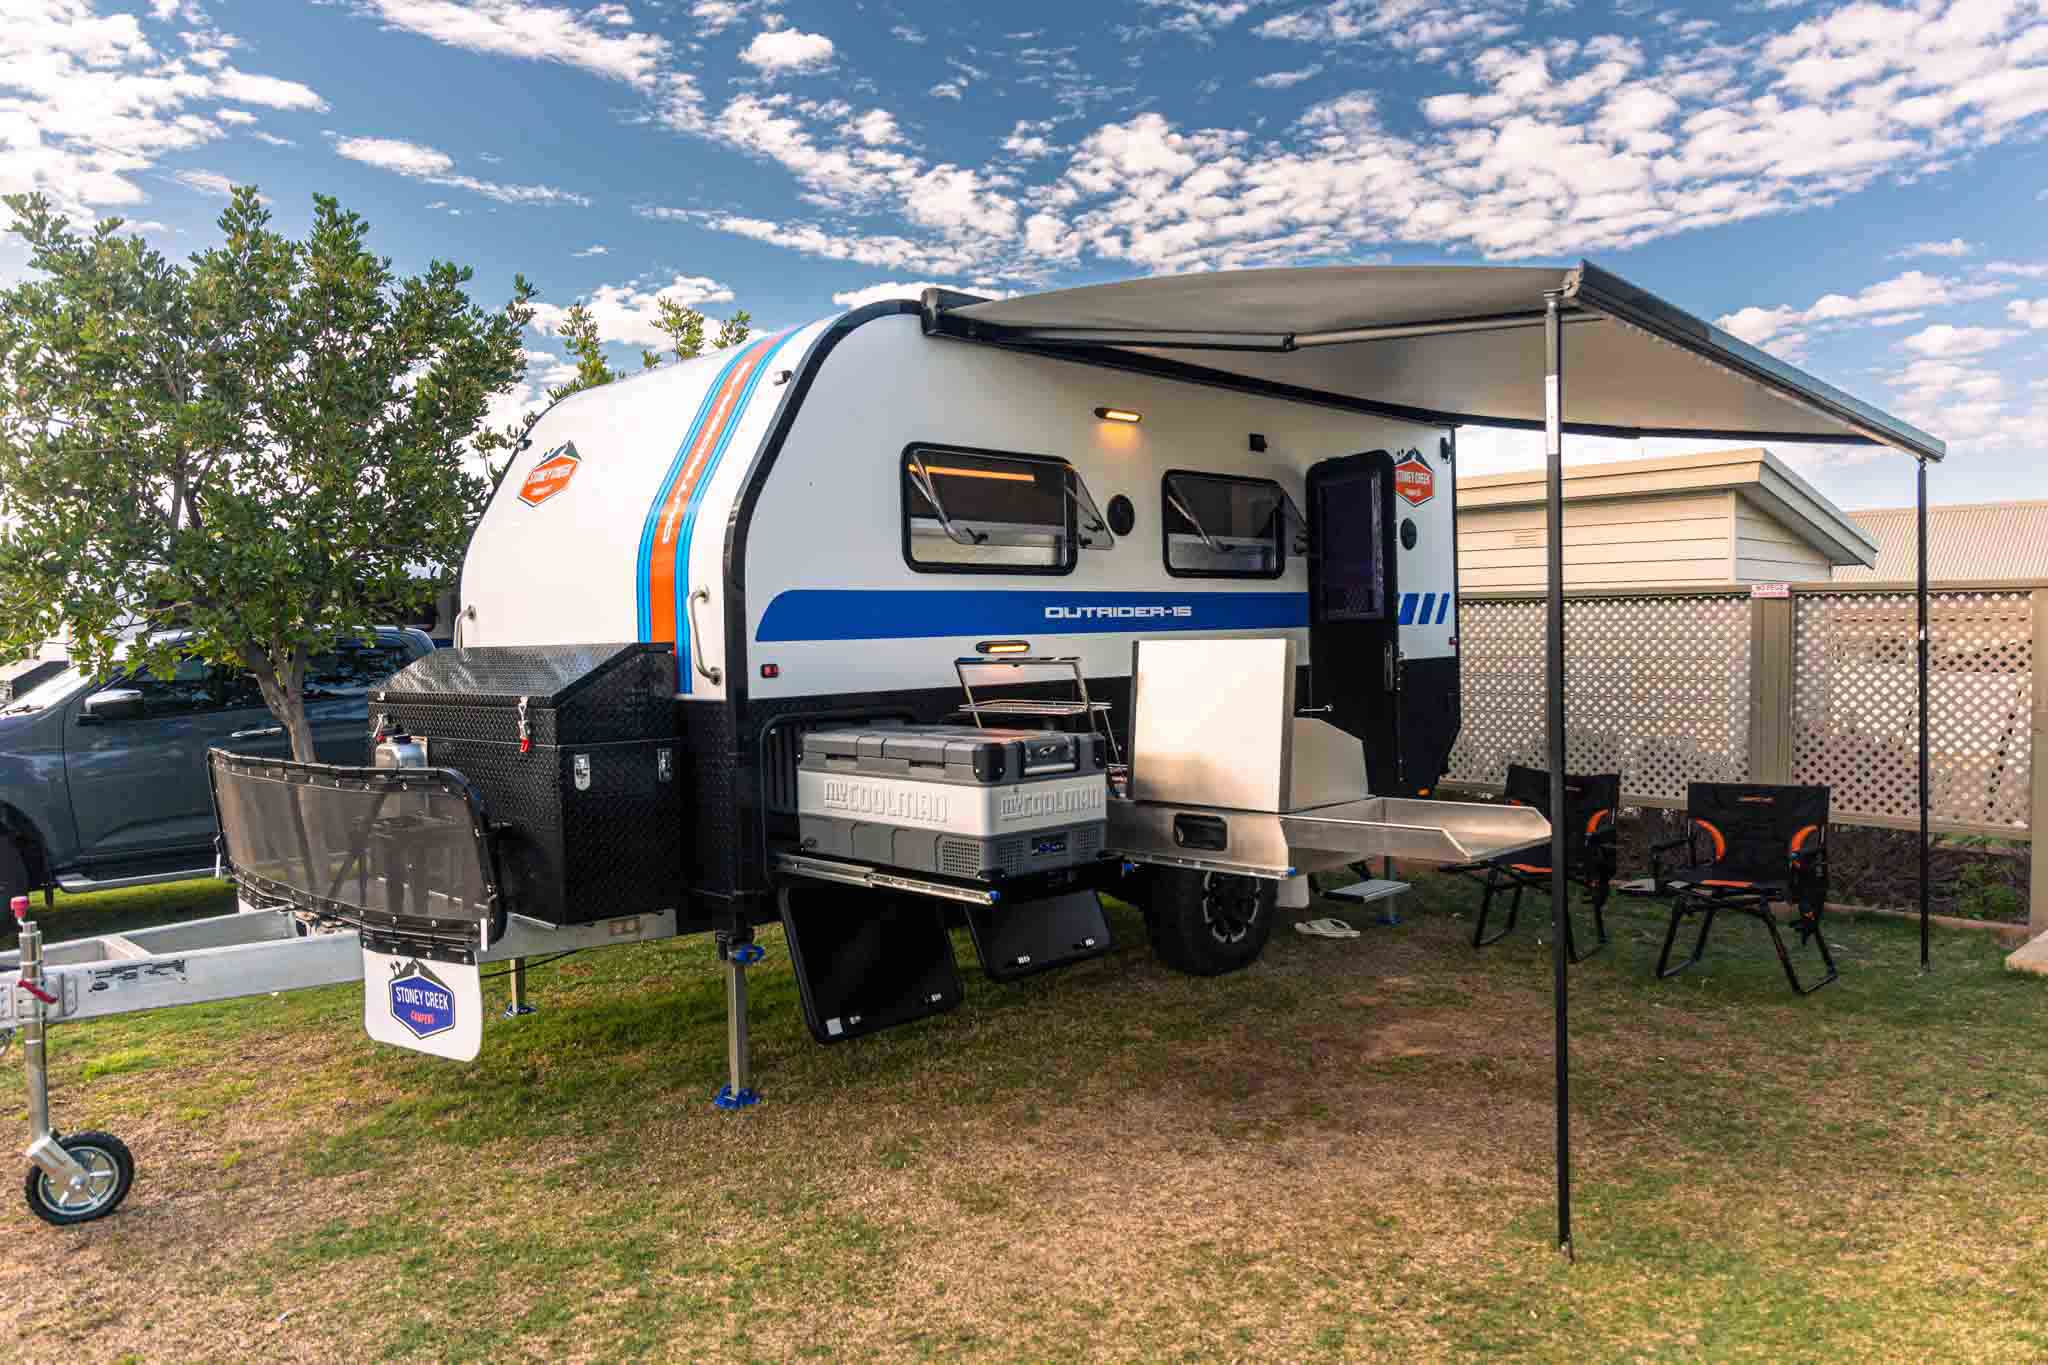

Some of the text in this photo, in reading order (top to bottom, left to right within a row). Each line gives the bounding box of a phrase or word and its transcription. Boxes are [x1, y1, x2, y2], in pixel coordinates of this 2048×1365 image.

[1044, 605, 1193, 619] OUTRIDER-15
[395, 986, 449, 1011] STONEY CREEK
